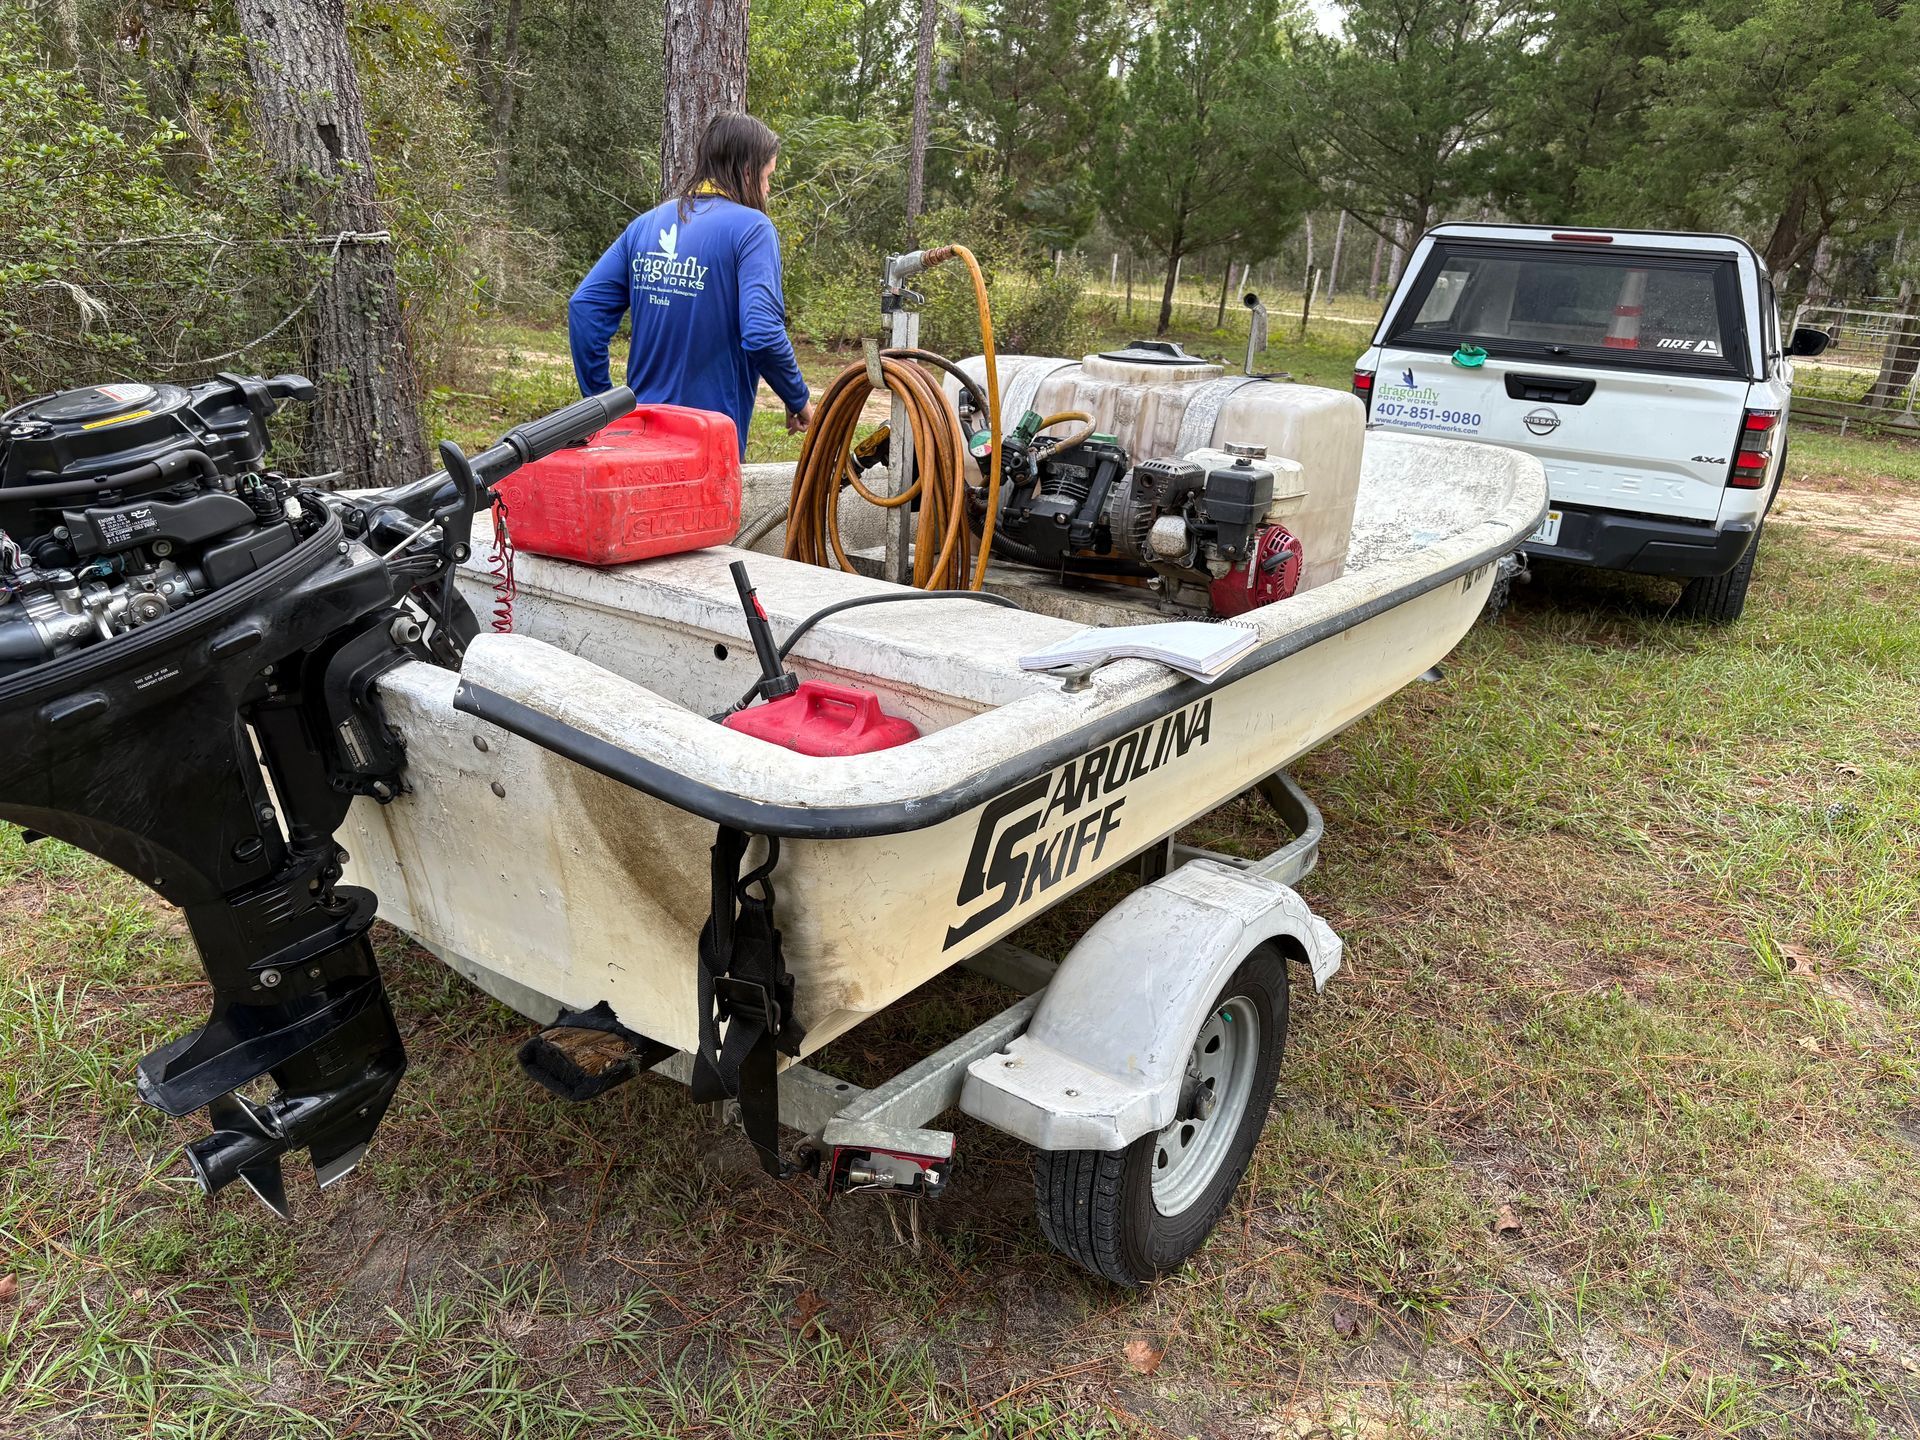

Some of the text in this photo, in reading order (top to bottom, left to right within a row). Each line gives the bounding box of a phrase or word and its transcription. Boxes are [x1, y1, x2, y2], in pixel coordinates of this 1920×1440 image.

[663, 276, 704, 290] WORKS
[1656, 338, 1694, 350] ARE
[1378, 394, 1438, 406] POND WORKS
[1379, 384, 1440, 400] dragonfly
[1377, 403, 1481, 426] 407-851-9080
[1523, 416, 1561, 426] NISSAN
[1375, 417, 1478, 435] www.dragonflypondworks.com
[624, 463, 687, 485] GASOLINE
[633, 508, 722, 538] SUZUKI
[957, 698, 1212, 906] CAROLINA
[942, 796, 1127, 952] SKIFF
